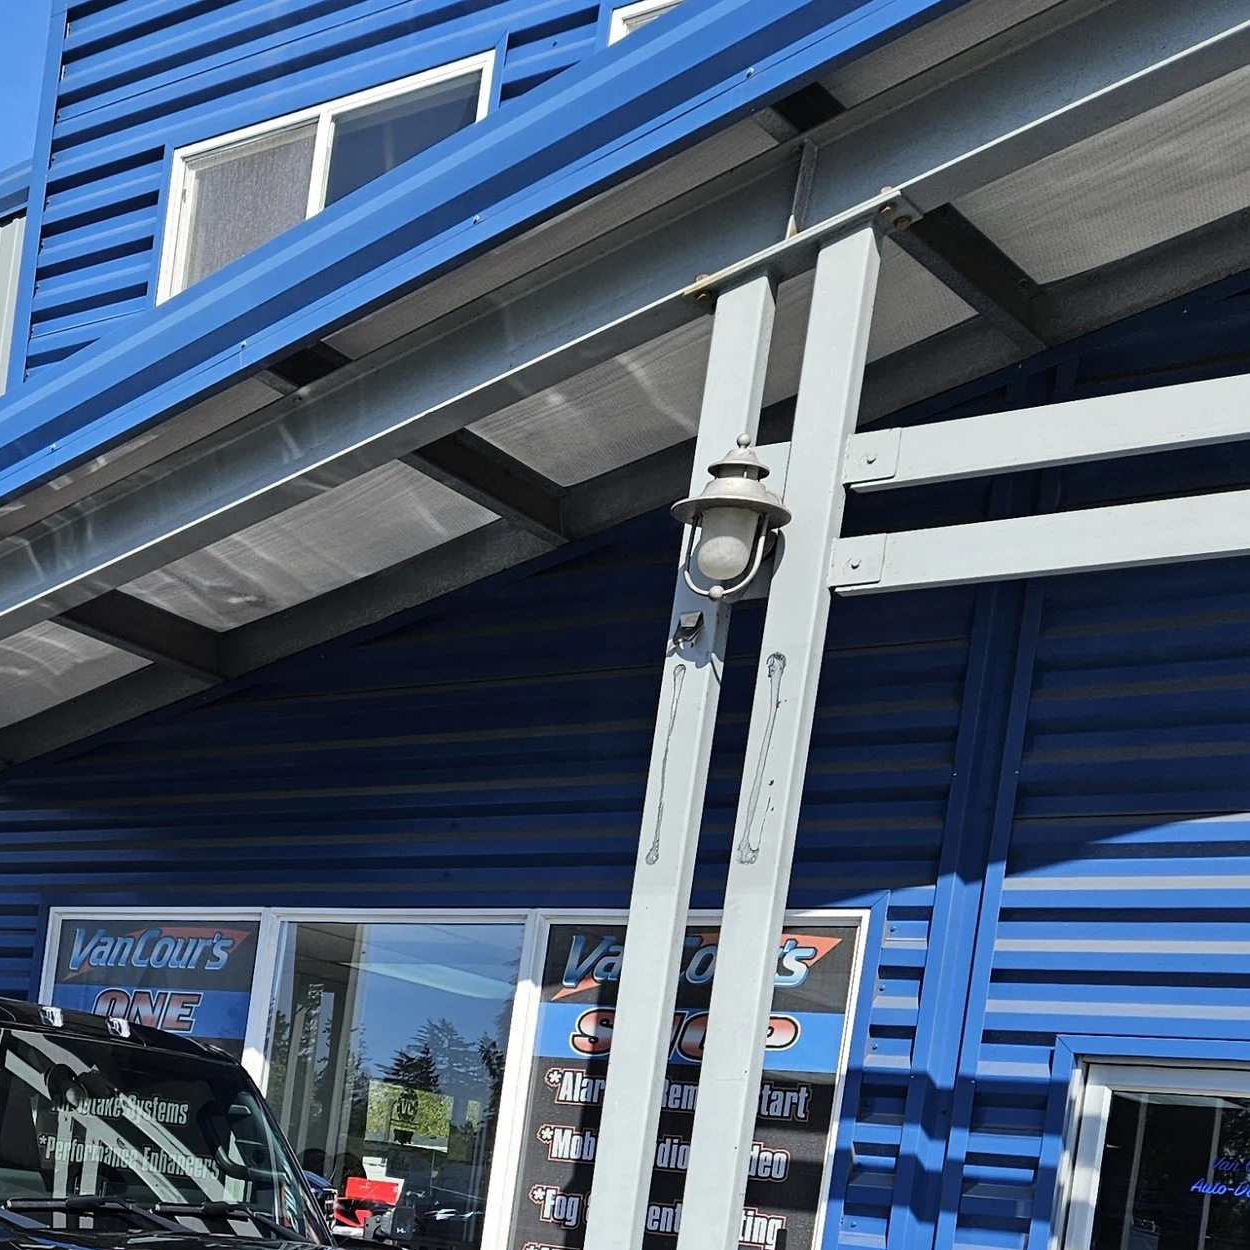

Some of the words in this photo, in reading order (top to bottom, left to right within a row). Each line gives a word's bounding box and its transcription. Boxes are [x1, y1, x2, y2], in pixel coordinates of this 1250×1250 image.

[69, 928, 234, 971] VanCour's
[92, 987, 203, 1034] ONE
[124, 1094, 189, 1125] Systems
[760, 1085, 809, 1119] tart
[141, 1146, 220, 1181] Enhancers
